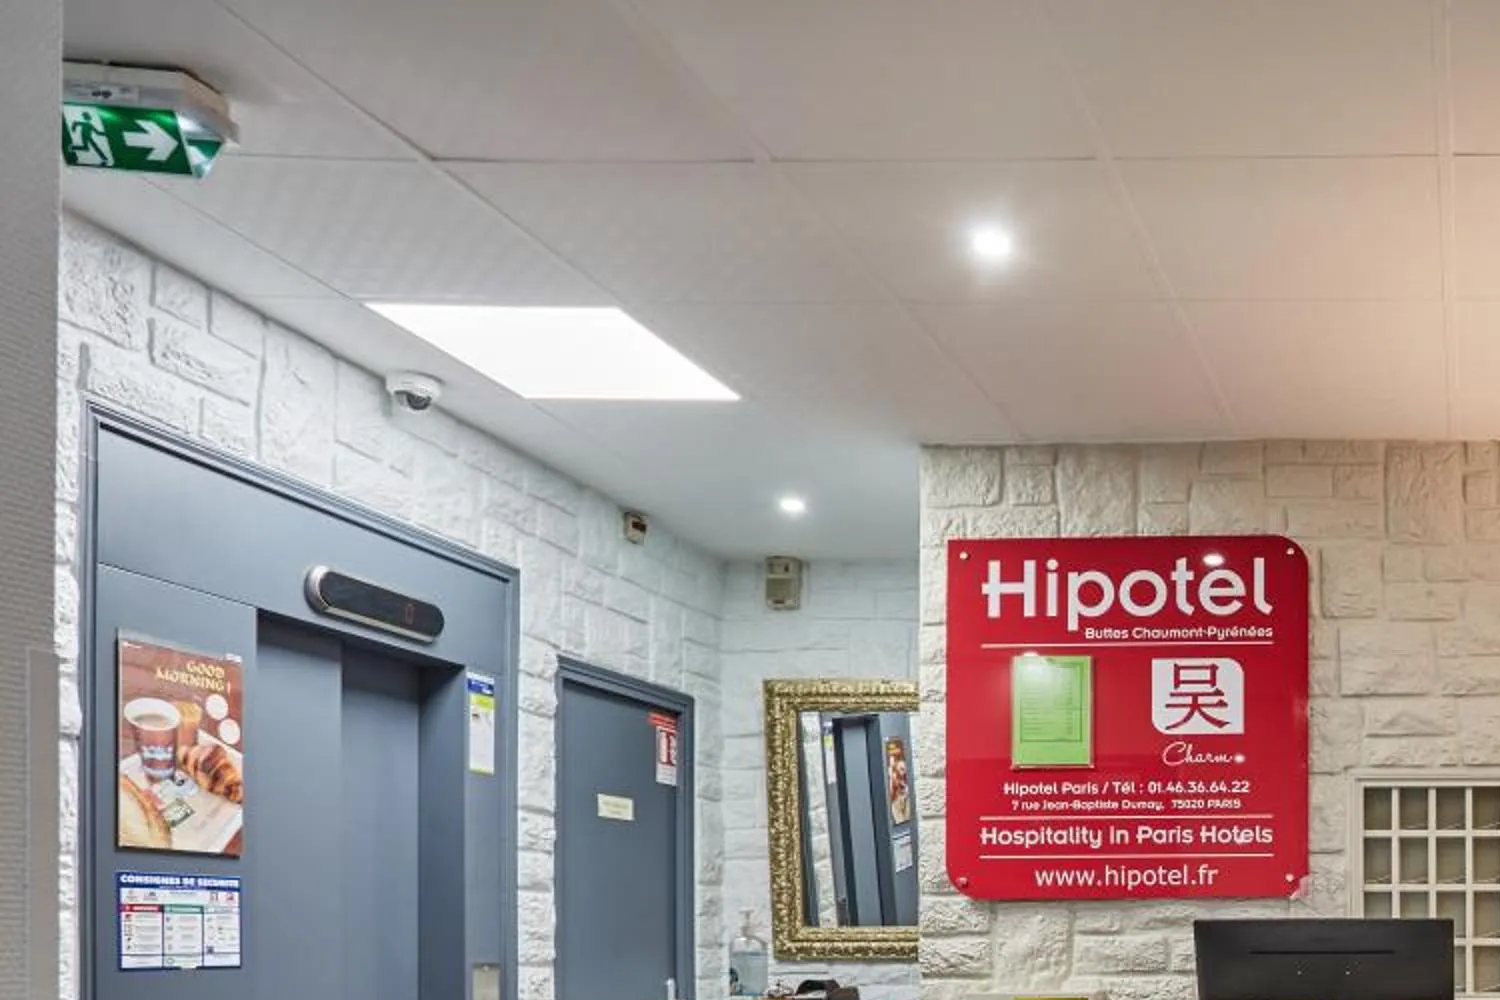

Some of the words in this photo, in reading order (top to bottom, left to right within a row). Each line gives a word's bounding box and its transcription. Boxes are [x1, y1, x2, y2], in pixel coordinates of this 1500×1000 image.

[981, 557, 1273, 632] Hipotel
[1085, 627, 1128, 640] Buttes
[186, 660, 225, 679] GOOD
[1003, 781, 1058, 796] Hipotel
[1062, 781, 1099, 795] Paris
[1112, 780, 1135, 794] Tél
[1011, 800, 1019, 811] 7
[1021, 801, 1041, 811] rue
[1207, 799, 1241, 809] PARIS
[980, 826, 1102, 848] Hospitality
[1136, 825, 1193, 844] Paris
[1200, 825, 1273, 844] Hotels
[1034, 865, 1219, 891] www.hipotel.fr
